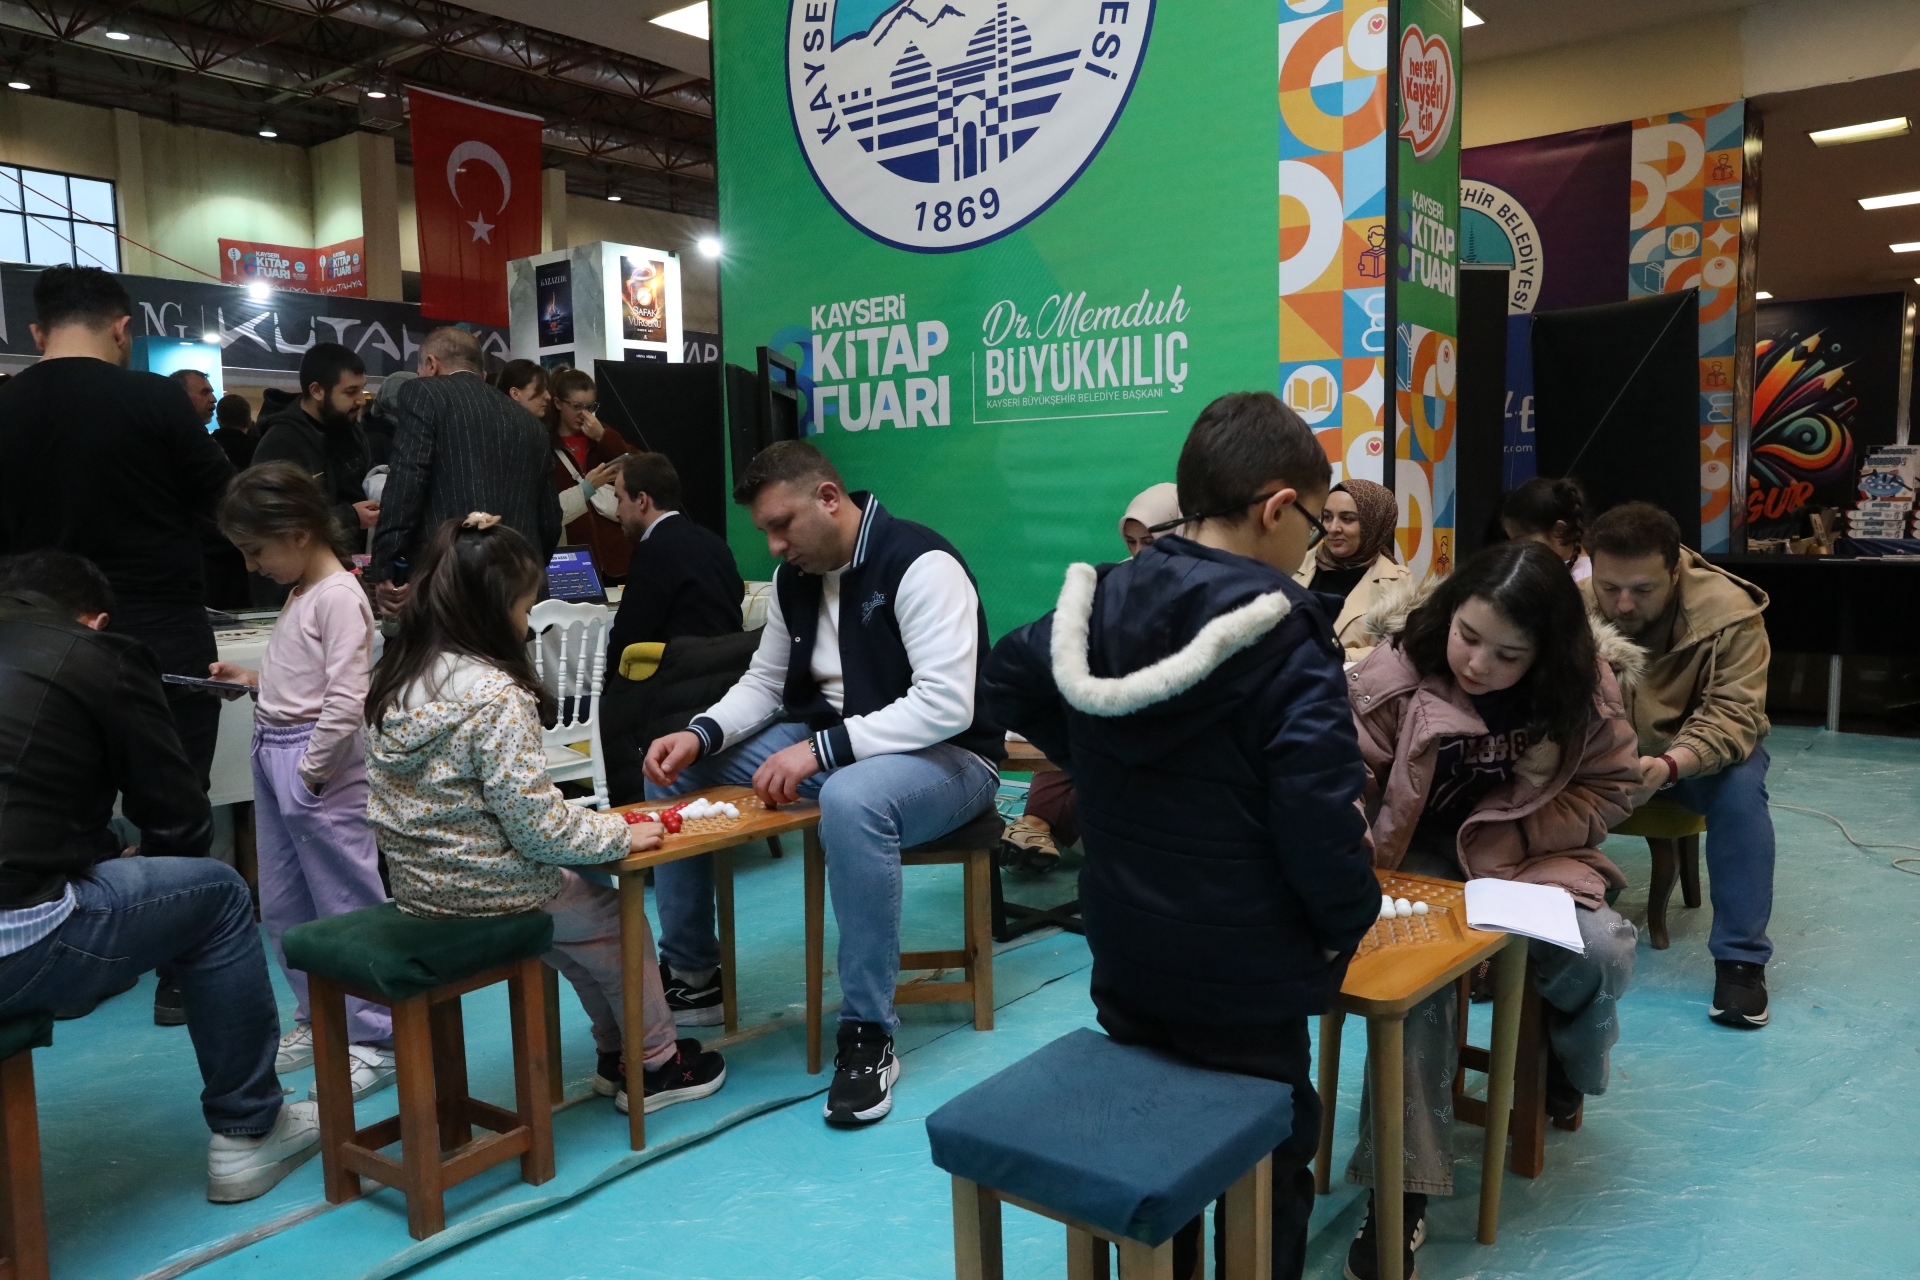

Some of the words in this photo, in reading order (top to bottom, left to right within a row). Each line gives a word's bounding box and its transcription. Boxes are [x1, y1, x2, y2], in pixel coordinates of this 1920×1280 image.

[1406, 75, 1444, 111] Kayseri
[1409, 57, 1423, 78] her
[1423, 59, 1438, 82] şey
[1418, 107, 1433, 134] için
[914, 187, 1000, 232] 1869
[1411, 210, 1455, 259] KİTAP
[1496, 203, 1538, 311] BELEDİYESİ
[256, 257, 290, 269] KİTAP
[1411, 247, 1456, 297] FUARI
[811, 293, 906, 331] KAYSERİ
[982, 299, 1032, 347] Dr.
[1036, 284, 1191, 339] Memduh
[811, 319, 949, 382] KİTAP
[985, 331, 1189, 397] BÜYÜKKILIÇ
[811, 375, 951, 434] FUARI
[986, 397, 1020, 409] KAYSERİ
[1022, 392, 1076, 406] BÜYÜKŞEHİR
[1078, 389, 1120, 403] BELEDİYE
[1122, 388, 1163, 401] BAŞKANI
